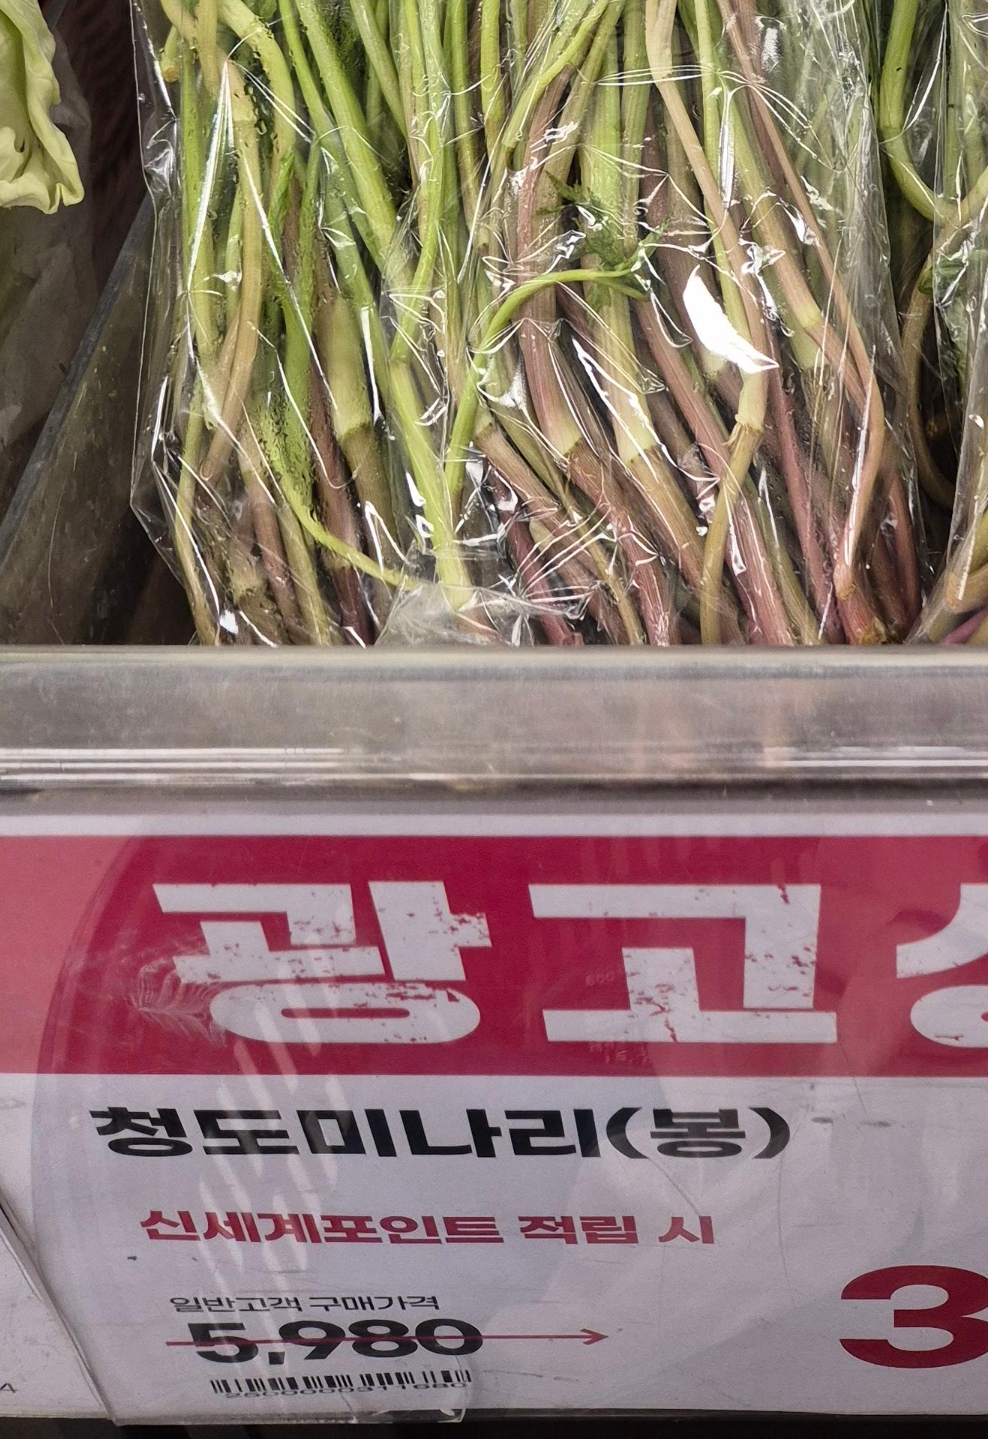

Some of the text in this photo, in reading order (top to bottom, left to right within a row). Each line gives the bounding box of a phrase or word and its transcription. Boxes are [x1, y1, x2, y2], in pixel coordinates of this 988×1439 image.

[91, 1106, 791, 1161] 청도미나리(봉)
[139, 1209, 714, 1245] 신세계포인트 적립 시
[169, 1294, 439, 1314] 일반고객 구매가격
[188, 1318, 483, 1365] 5,980
